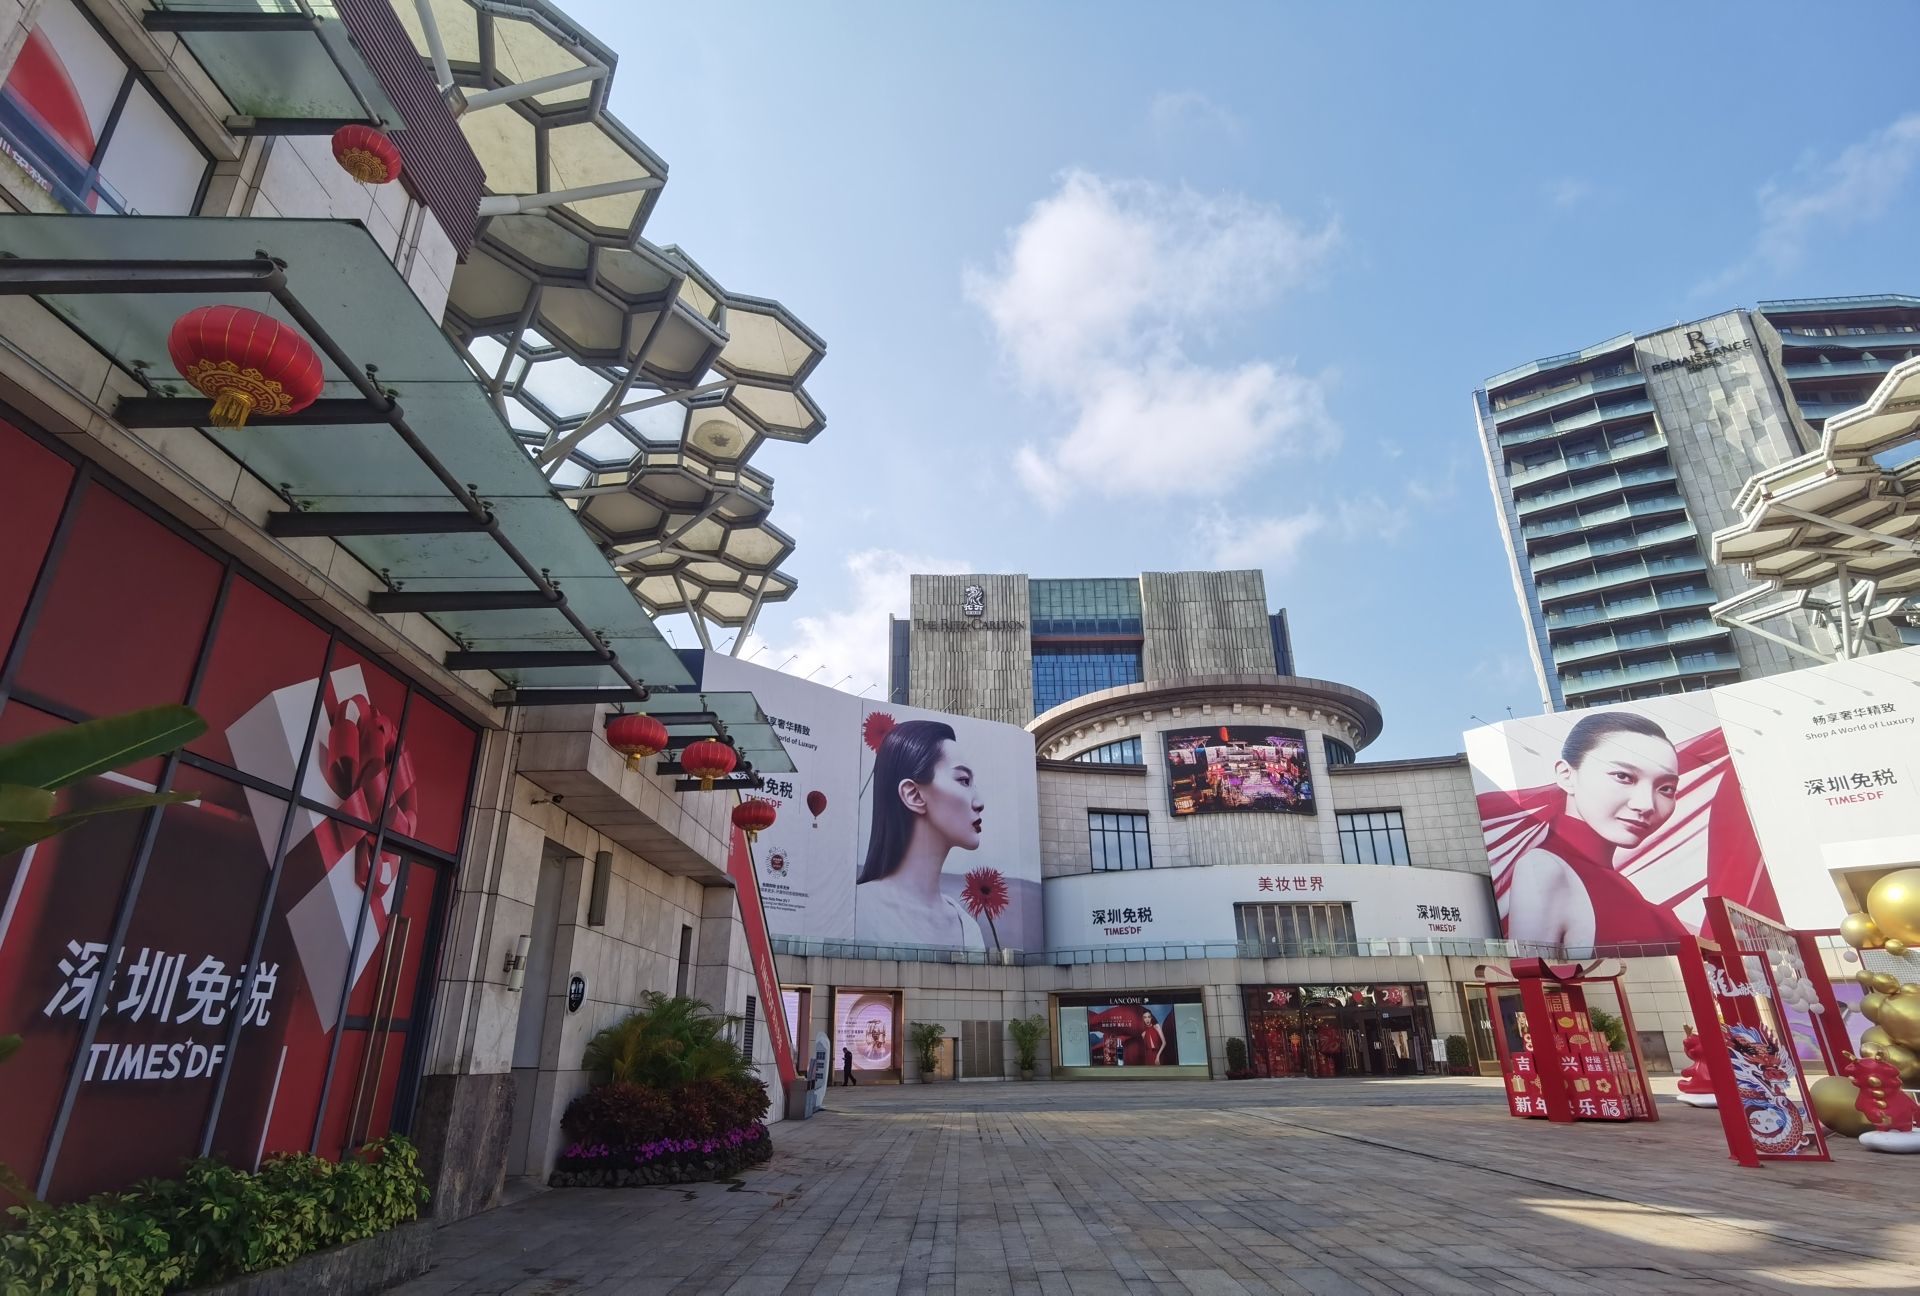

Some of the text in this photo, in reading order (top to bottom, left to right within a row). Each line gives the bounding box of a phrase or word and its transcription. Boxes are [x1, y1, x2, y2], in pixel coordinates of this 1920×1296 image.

[1684, 330, 1714, 350] R
[1651, 338, 1753, 374] RENAISSANCE
[914, 618, 938, 631] THE
[1811, 702, 1897, 726] 畅享奢华精致
[1805, 730, 1829, 740] Shop
[1838, 724, 1867, 735] World
[1869, 721, 1879, 730] of
[1882, 716, 1915, 728] Luxury
[777, 734, 818, 751] orld of Luxury
[1803, 767, 1898, 796] 深圳免税
[1257, 875, 1325, 892] 美妆世界
[1092, 906, 1153, 925] 深圳免税
[1416, 904, 1462, 923] 深圳免税
[43, 938, 280, 1028] 深圳免税
[1515, 1055, 1579, 1072] 吉 兴
[1585, 1056, 1602, 1065] 好运
